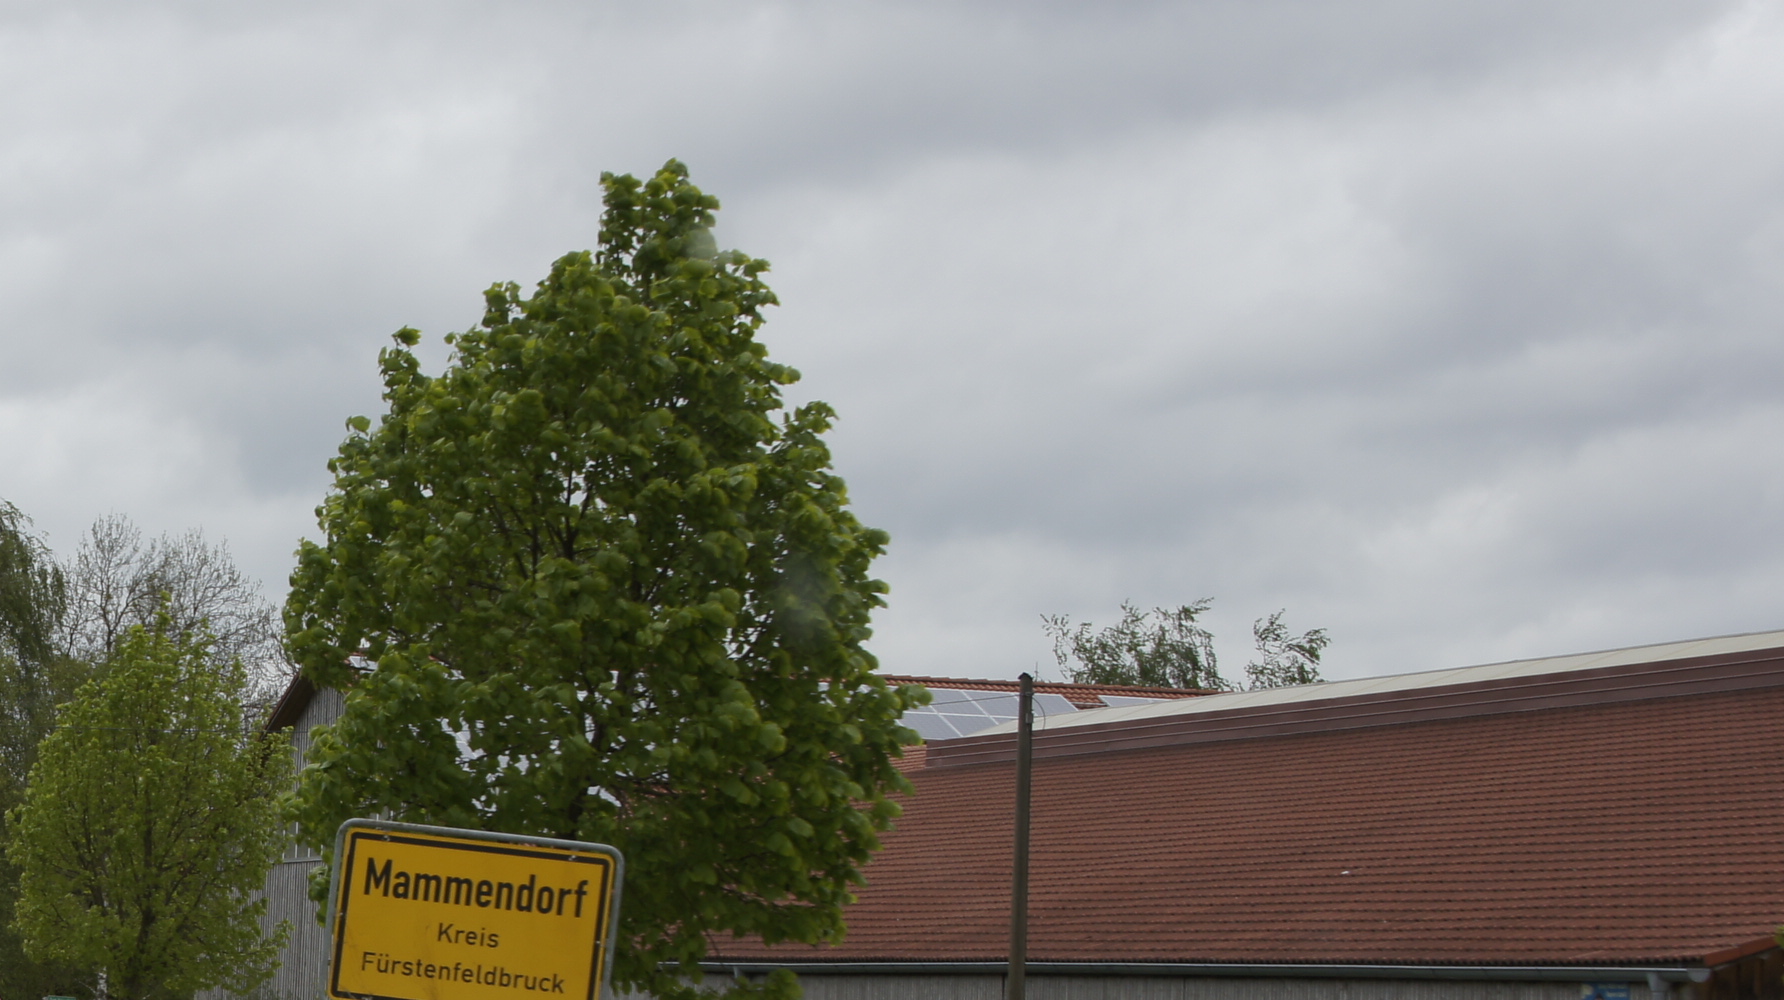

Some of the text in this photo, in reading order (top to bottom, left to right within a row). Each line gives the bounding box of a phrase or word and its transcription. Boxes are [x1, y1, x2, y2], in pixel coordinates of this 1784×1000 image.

[364, 857, 589, 918] Mammendorf
[437, 922, 499, 948] Kreis
[361, 951, 565, 994] Fürstenfeldbruck
